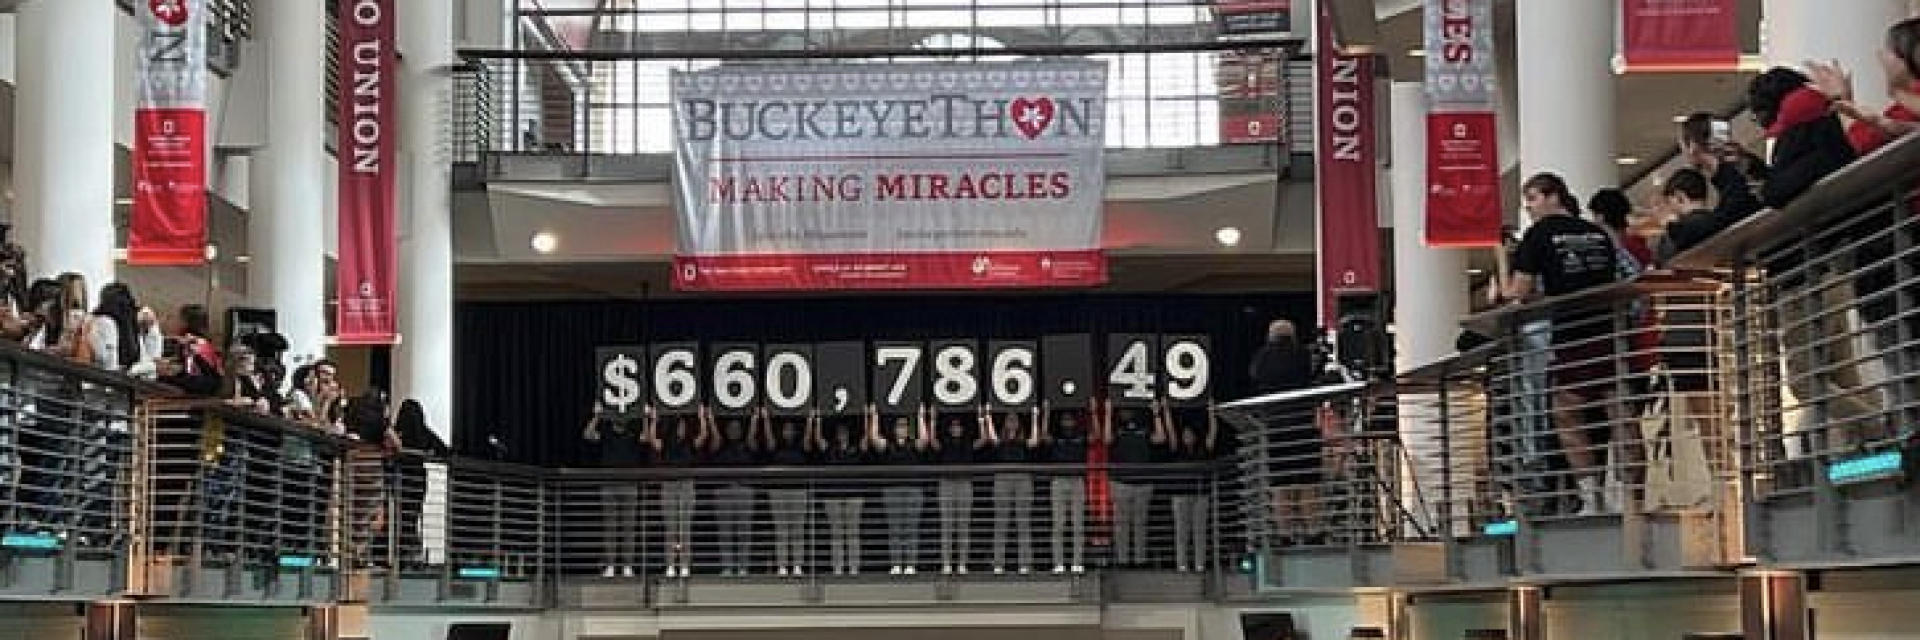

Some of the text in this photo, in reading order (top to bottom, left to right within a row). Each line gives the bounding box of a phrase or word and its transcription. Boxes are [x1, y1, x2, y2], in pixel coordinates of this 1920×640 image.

[353, 39, 381, 175] UNION
[1332, 34, 1361, 162] NION
[710, 172, 1070, 203] MAKING MIRACLES
